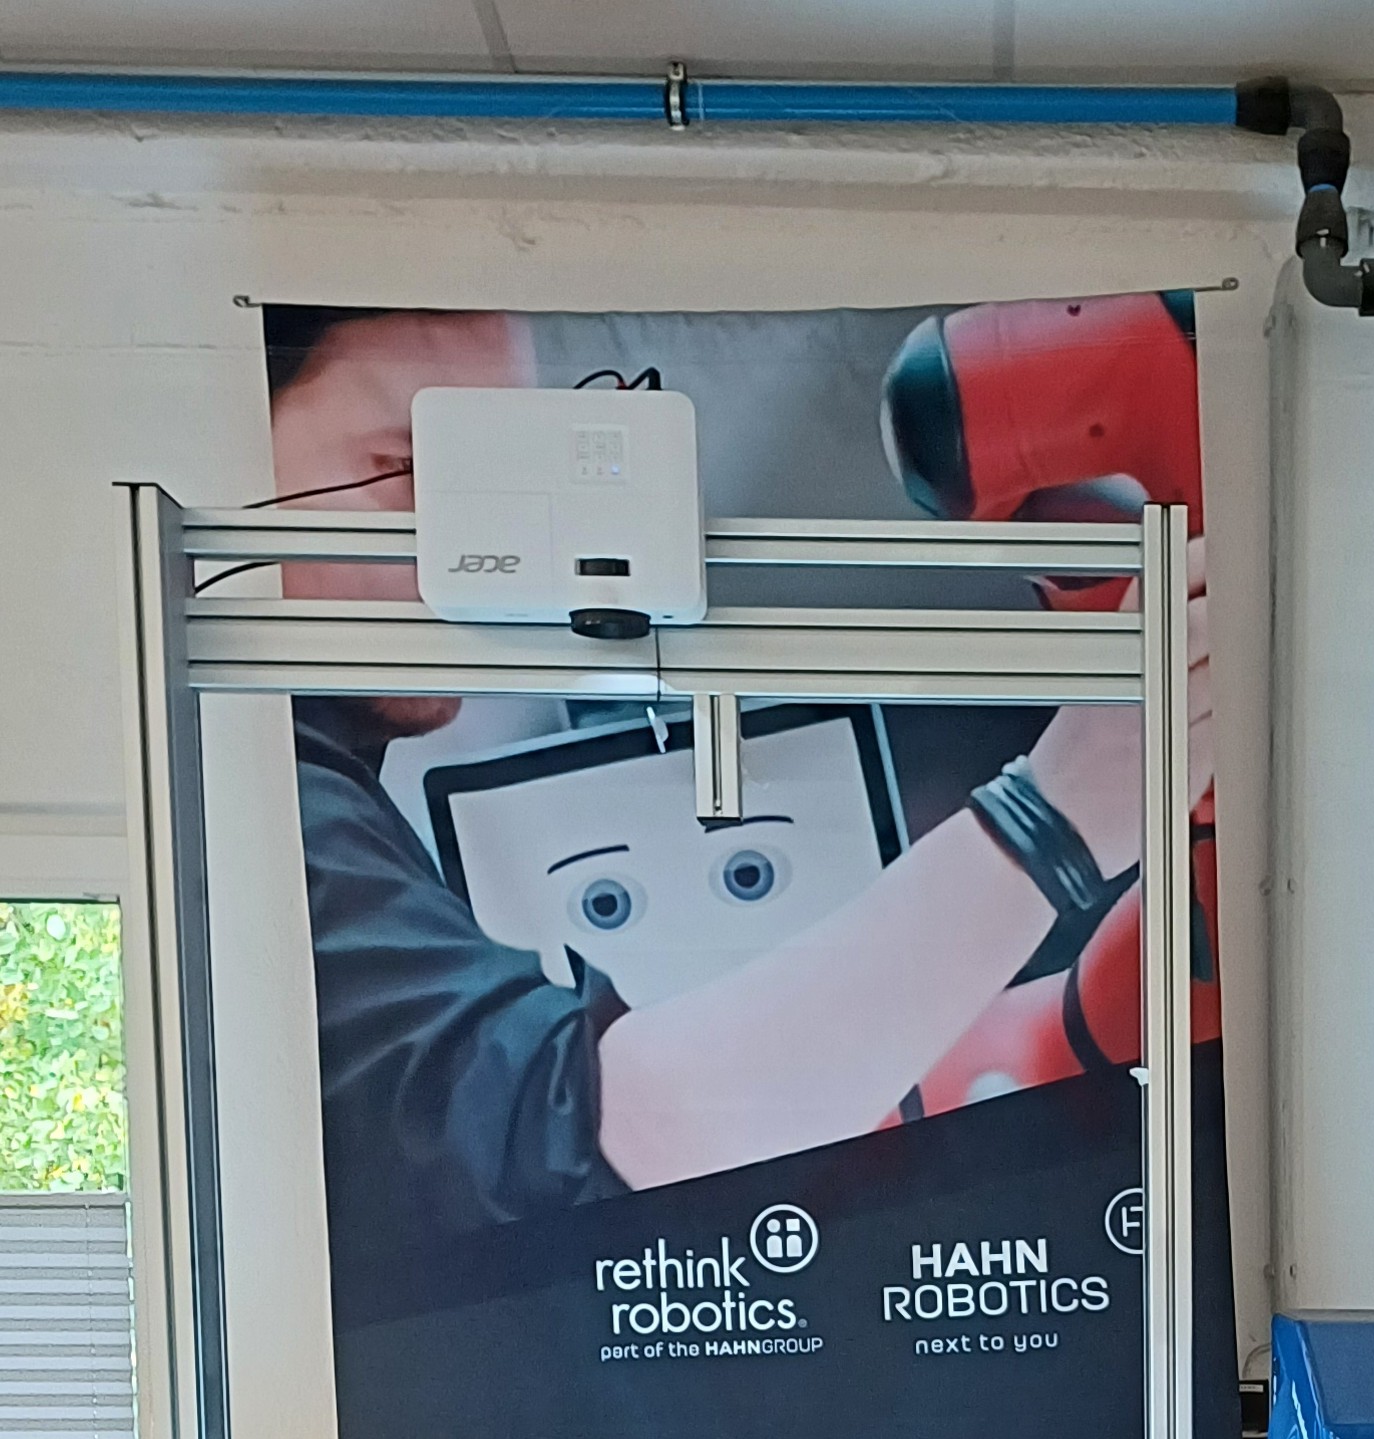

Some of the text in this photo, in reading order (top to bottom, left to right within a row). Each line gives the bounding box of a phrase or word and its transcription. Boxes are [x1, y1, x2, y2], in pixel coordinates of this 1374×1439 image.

[447, 554, 521, 573] acer
[596, 1236, 750, 1290] rethink
[911, 1238, 1048, 1279] HAHN
[883, 1276, 1110, 1321] ROBOTICS
[601, 1337, 823, 1362] part of the HAHNGROUP
[915, 1332, 1058, 1354] next to you
